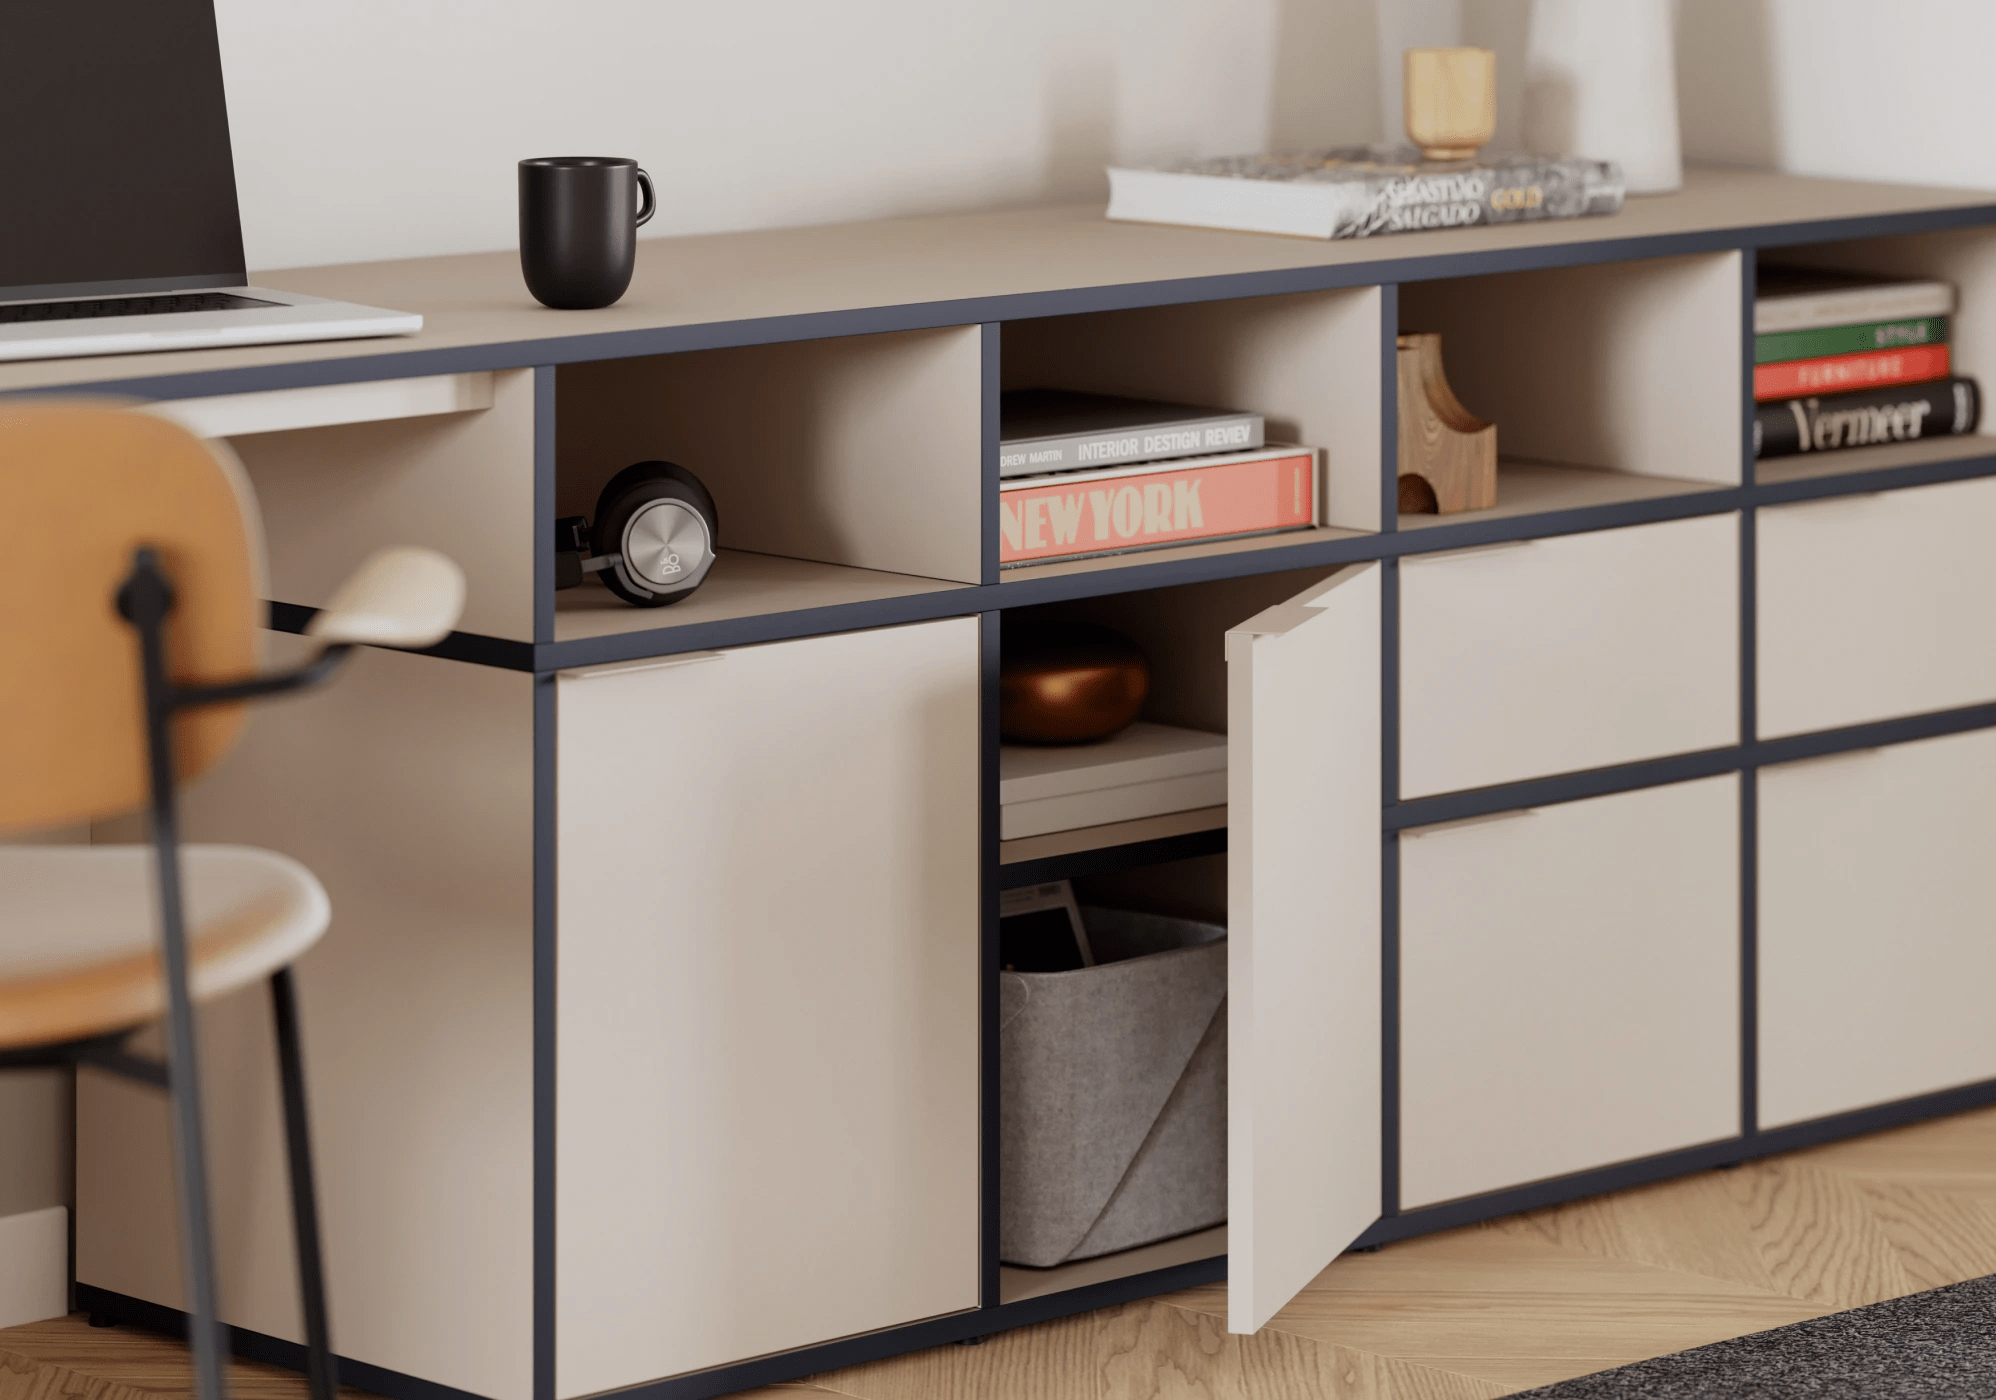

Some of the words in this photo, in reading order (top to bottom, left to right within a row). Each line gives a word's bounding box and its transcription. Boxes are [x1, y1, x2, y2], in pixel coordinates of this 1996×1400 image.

[1490, 186, 1543, 211] GOLD
[1797, 356, 1903, 387] FURNITURE
[1788, 397, 1932, 452] Vermeer
[1000, 453, 1027, 467] DREW
[1029, 449, 1063, 464] MARTIN
[1077, 438, 1139, 461] INTERIOR
[1000, 491, 1086, 552] NEW
[1089, 477, 1205, 541] YORK
